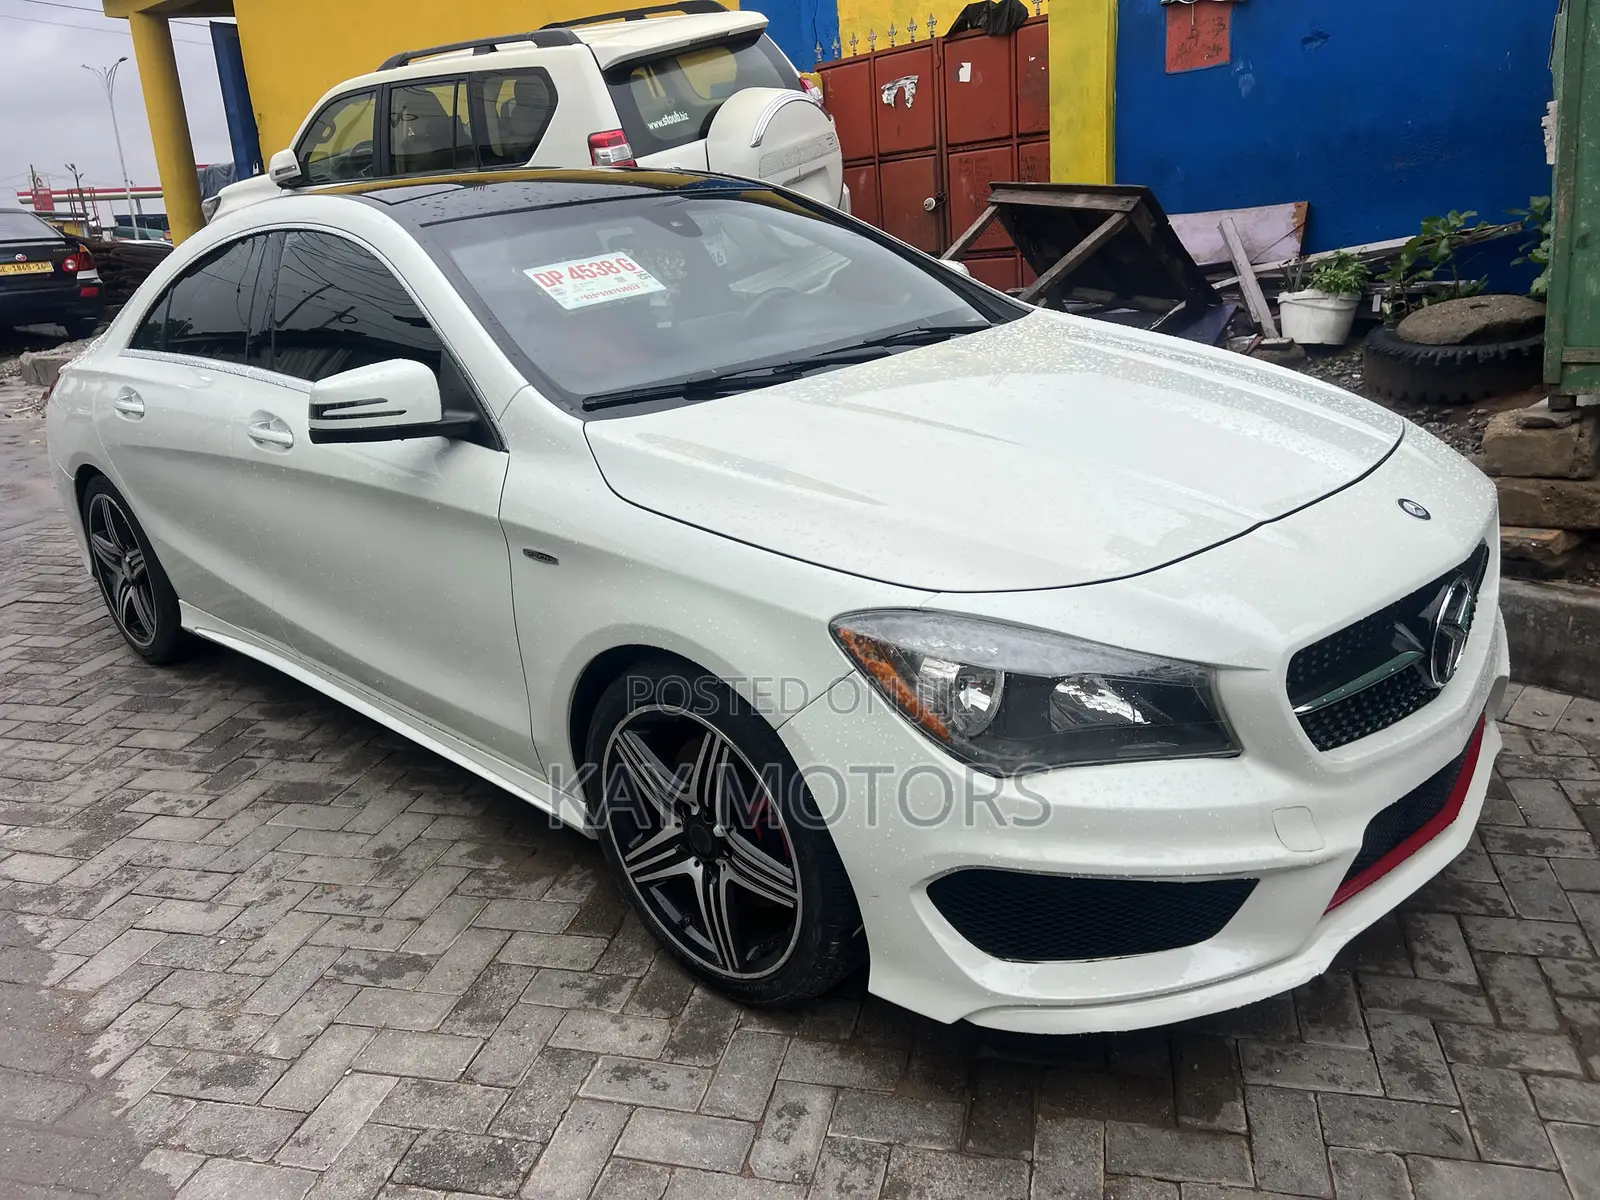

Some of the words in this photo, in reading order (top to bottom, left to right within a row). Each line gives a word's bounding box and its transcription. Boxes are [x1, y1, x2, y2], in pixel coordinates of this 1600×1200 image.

[533, 270, 564, 288] DP
[568, 260, 621, 280] 4538
[615, 258, 637, 272] G
